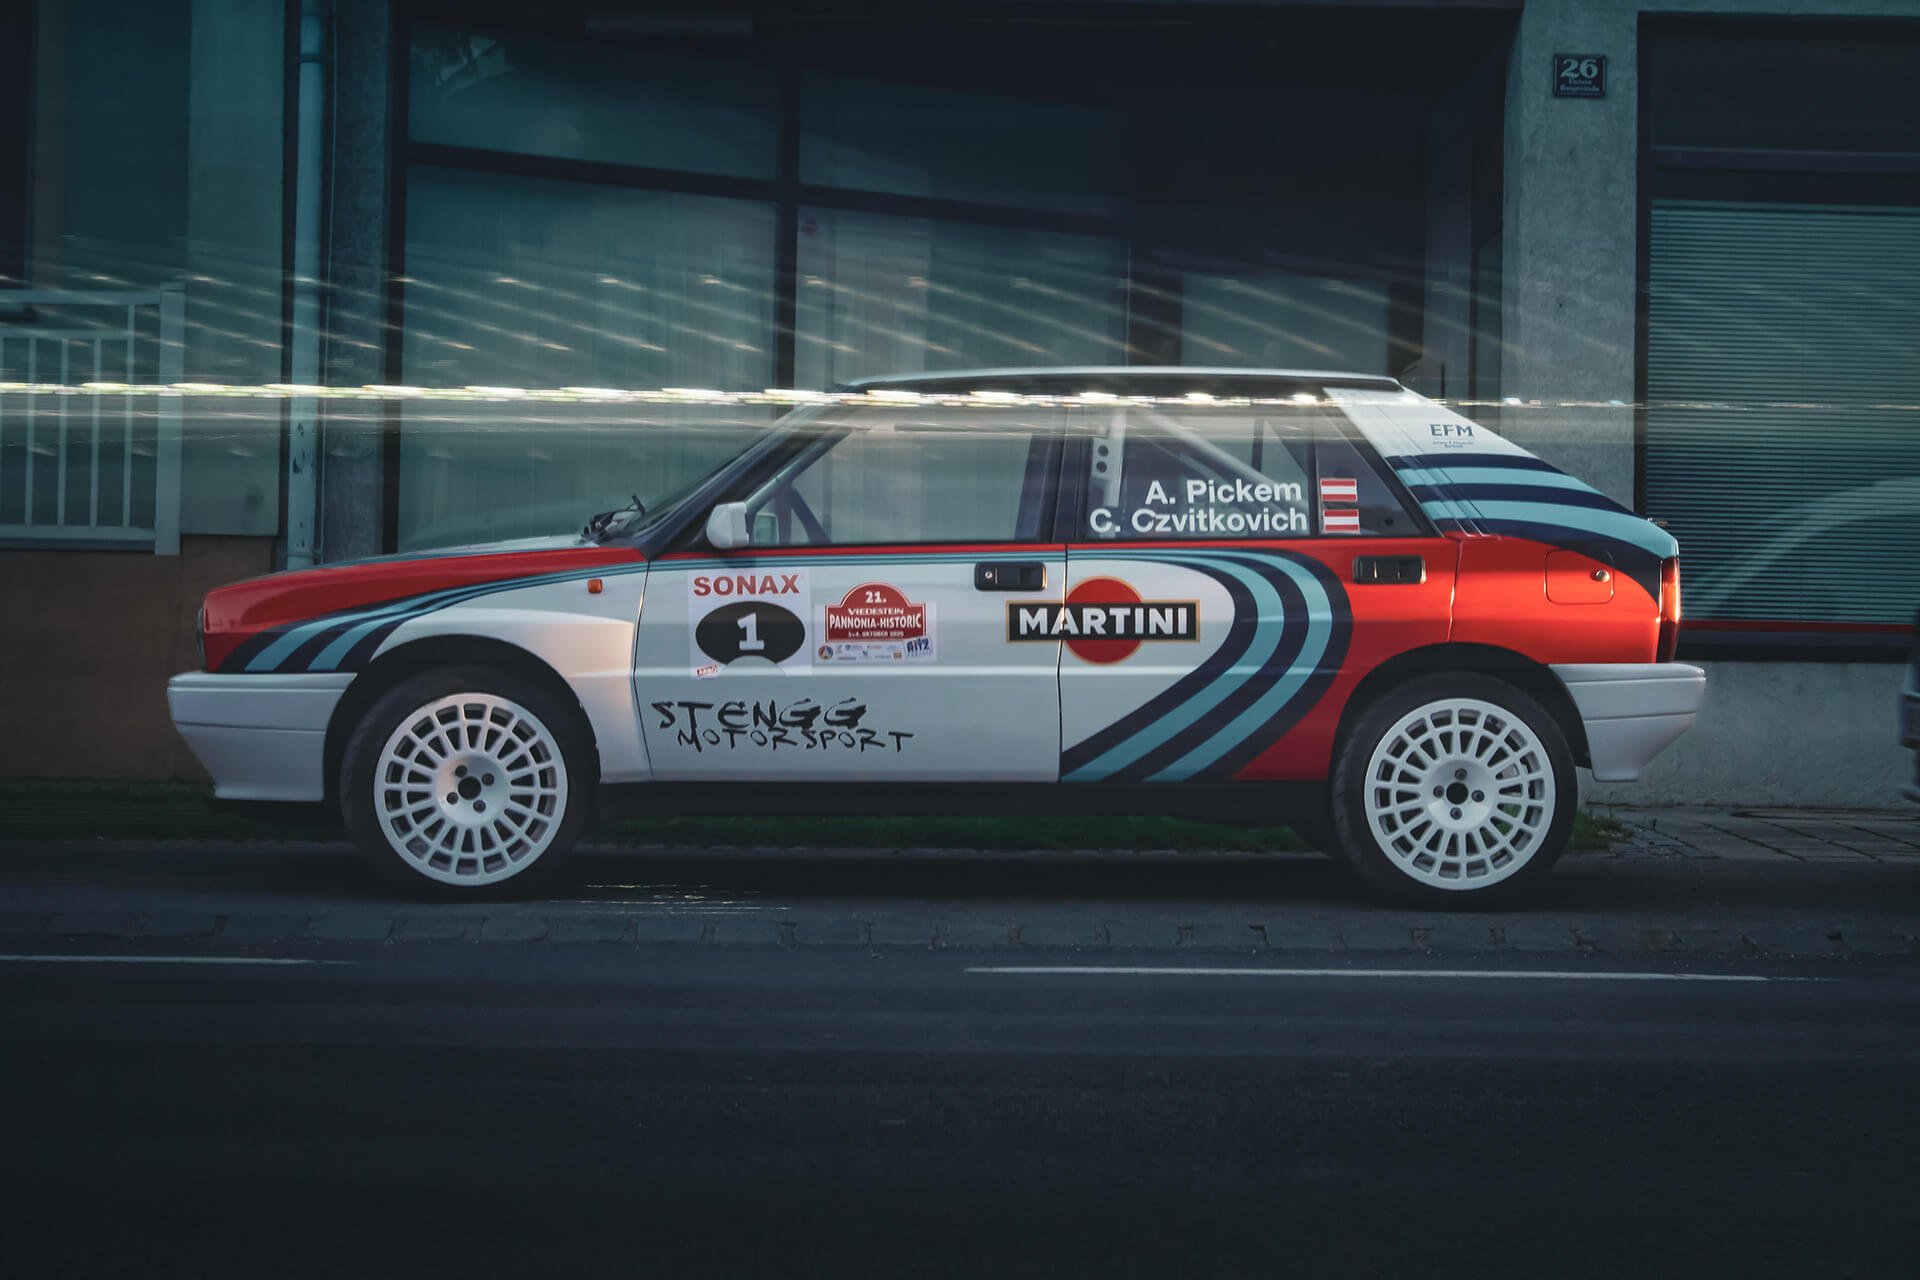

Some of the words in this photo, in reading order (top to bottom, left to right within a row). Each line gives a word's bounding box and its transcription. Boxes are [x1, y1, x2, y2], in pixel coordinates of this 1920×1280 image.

[1560, 58, 1598, 79] 26
[1430, 423, 1474, 437] EFM
[1145, 480, 1176, 505] A.
[1187, 478, 1302, 504] Pickem
[1089, 508, 1121, 533] C.
[1131, 506, 1308, 533] Czvitkovich
[693, 574, 800, 597] SONAX
[865, 590, 887, 603] 21.
[737, 611, 765, 651] 1
[1019, 607, 1187, 635] MARTINI
[651, 697, 867, 731] STENGG
[677, 727, 915, 752] MOTORSPORT
